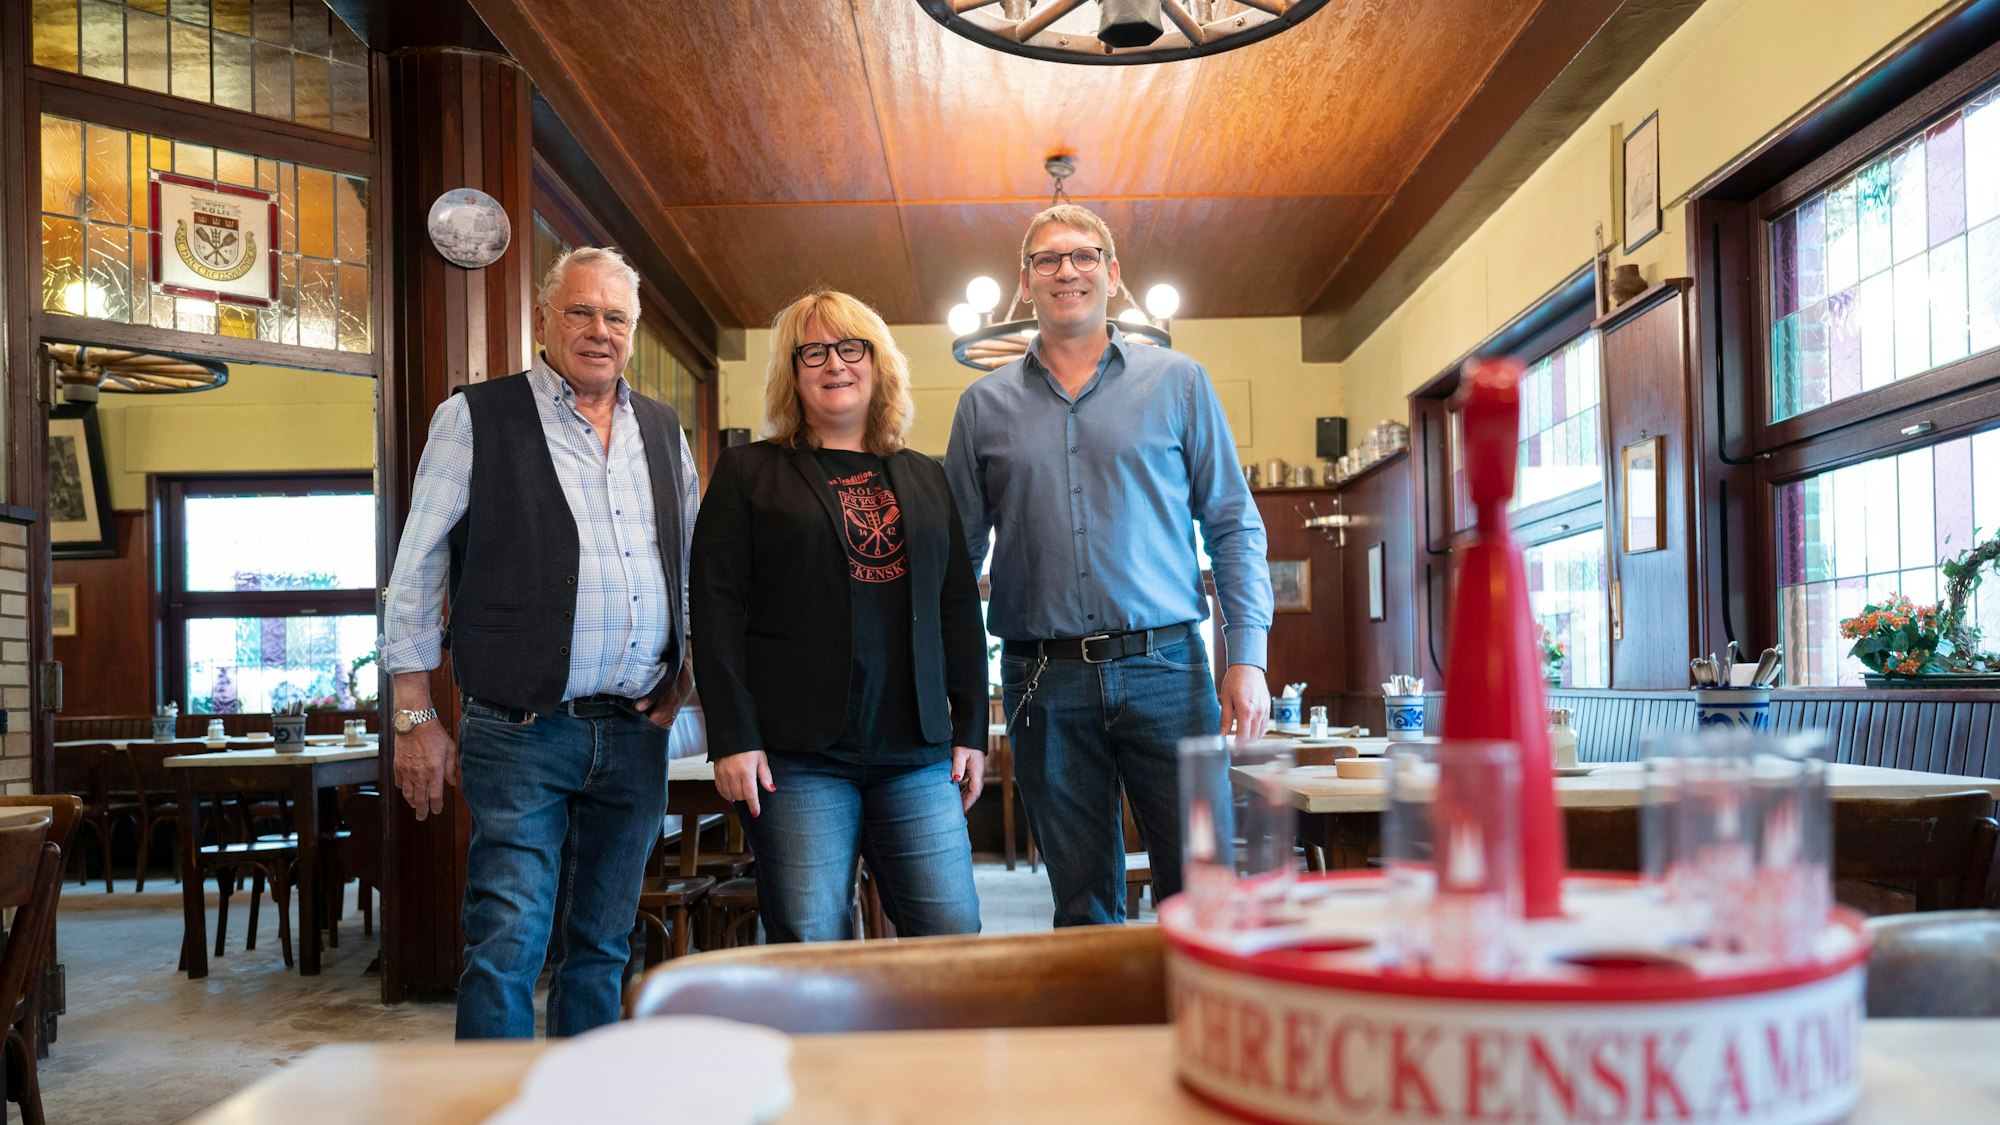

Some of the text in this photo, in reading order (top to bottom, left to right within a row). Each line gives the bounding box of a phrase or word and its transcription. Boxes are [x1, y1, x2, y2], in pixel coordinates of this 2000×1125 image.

[202, 206, 230, 216] KÖLN
[848, 485, 883, 496] KÖLN
[858, 526, 897, 537] 14 42
[849, 561, 908, 580] CKENSK
